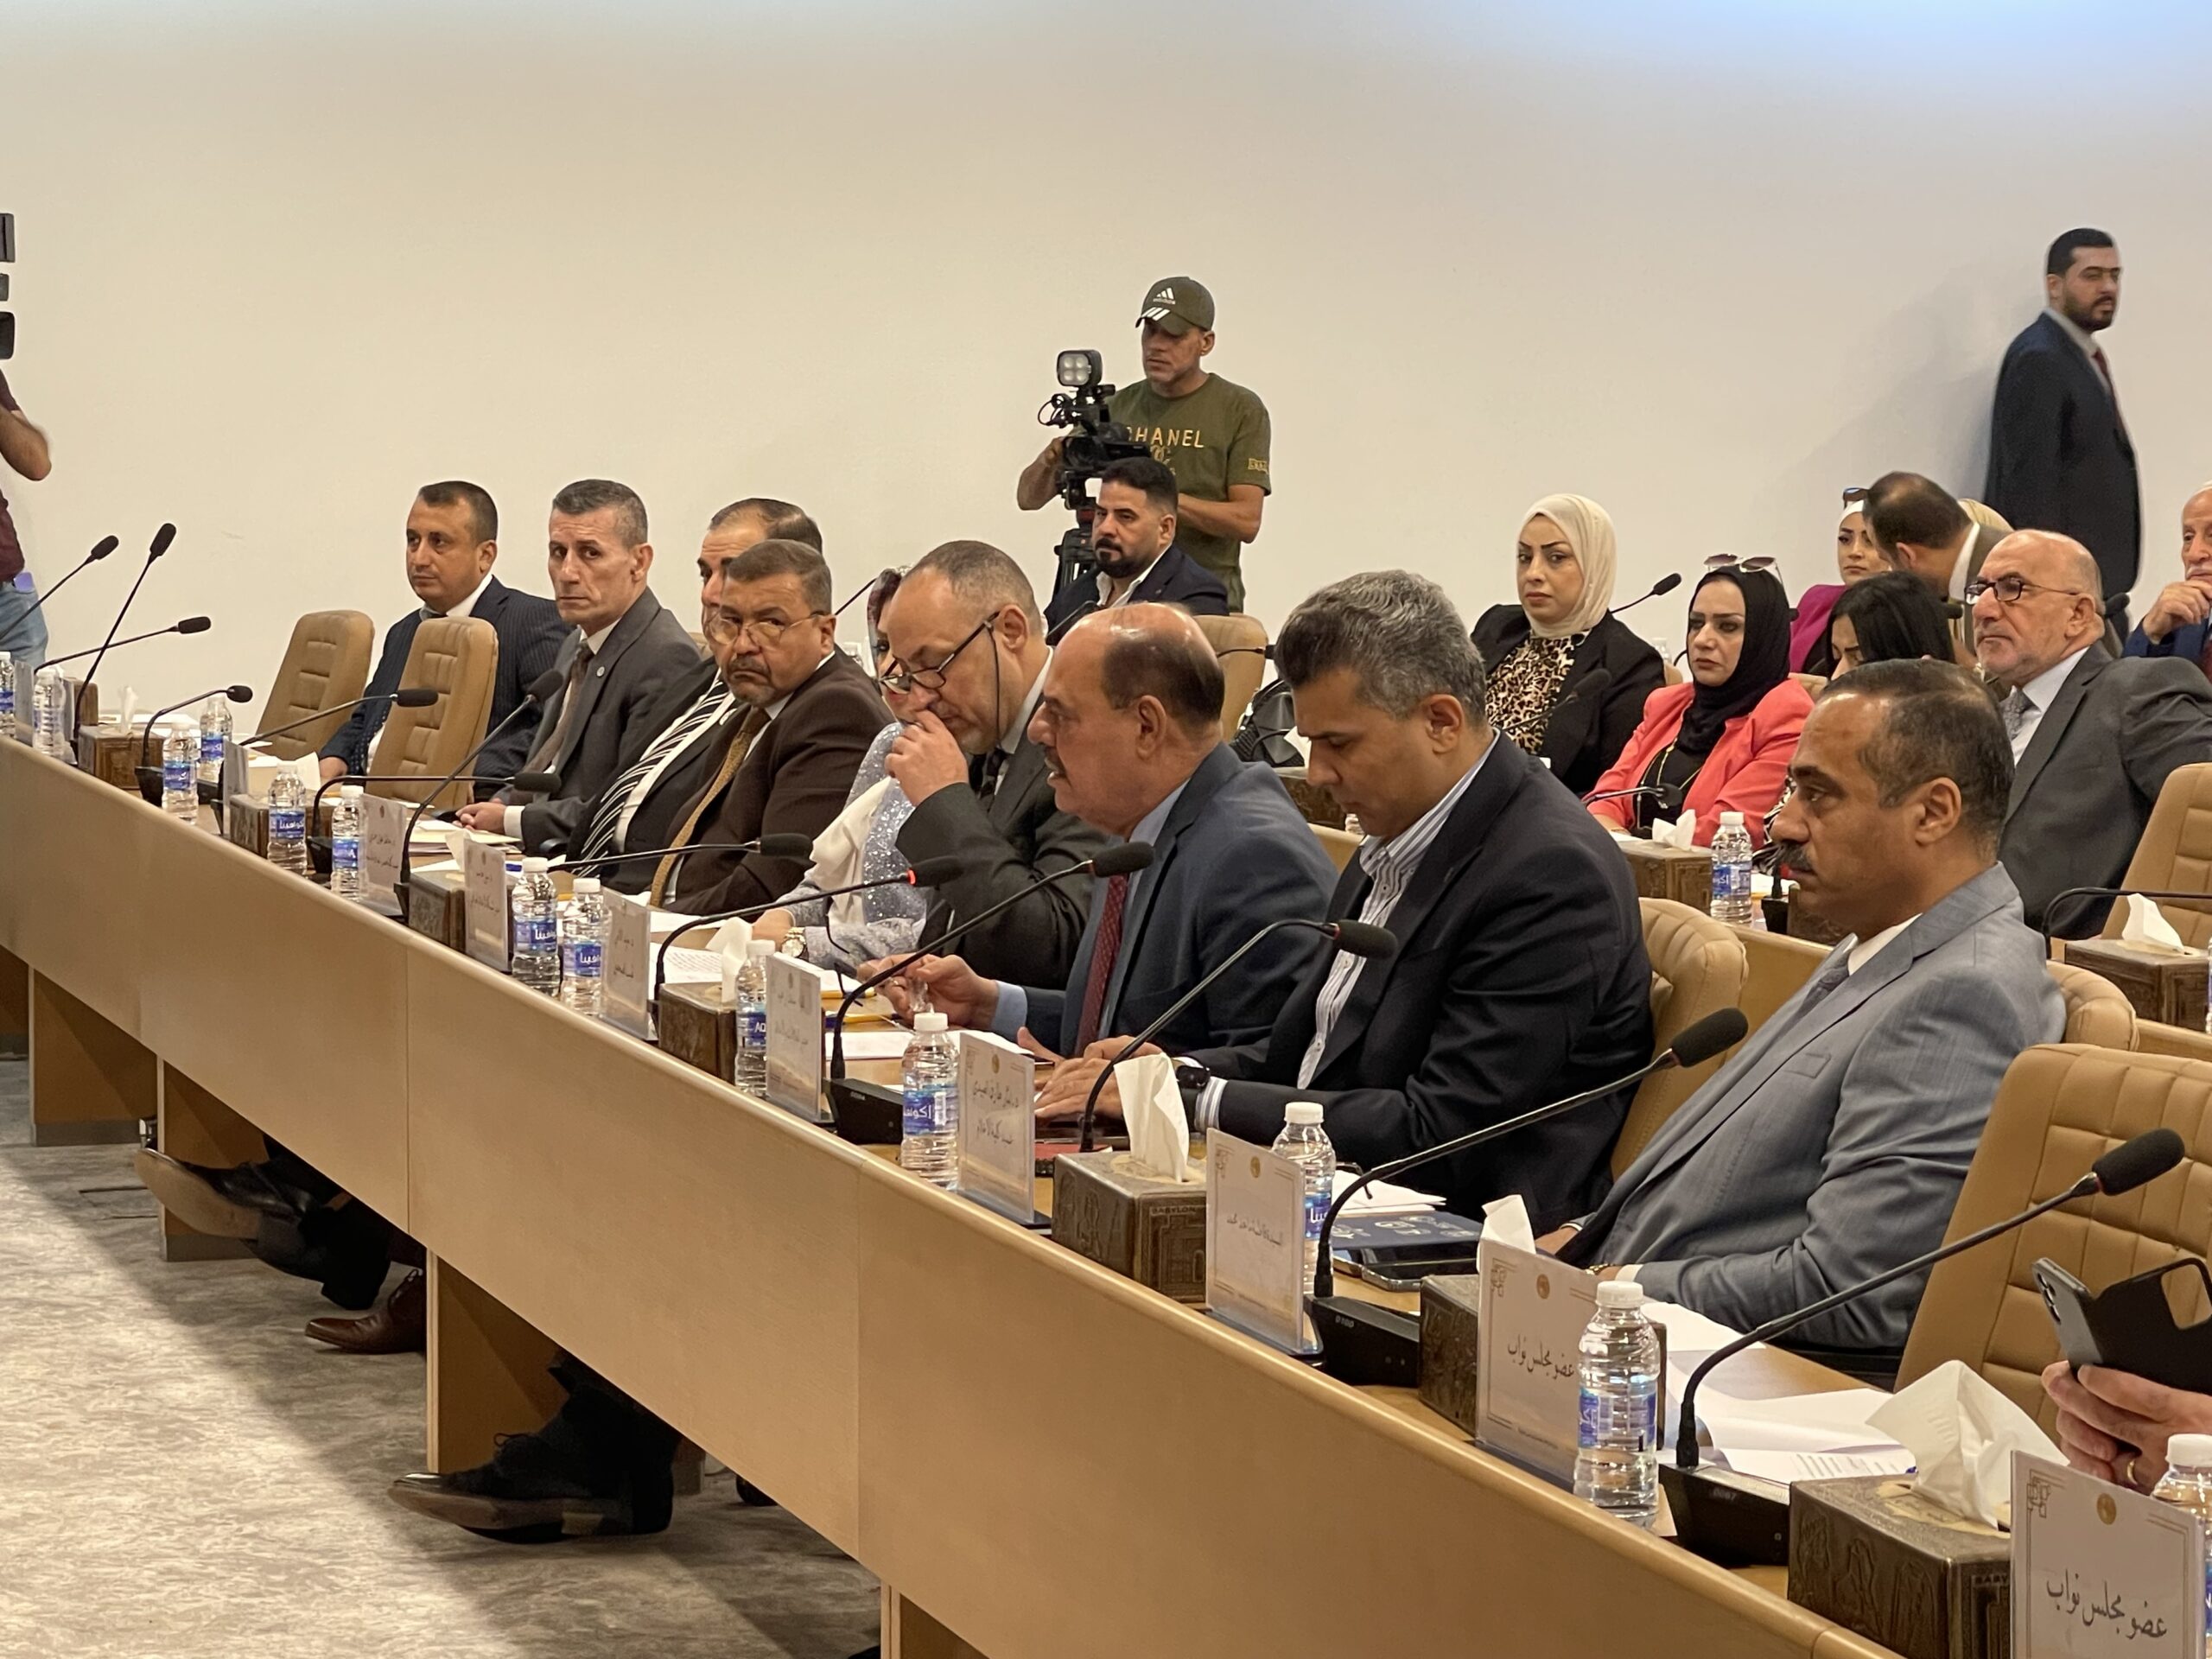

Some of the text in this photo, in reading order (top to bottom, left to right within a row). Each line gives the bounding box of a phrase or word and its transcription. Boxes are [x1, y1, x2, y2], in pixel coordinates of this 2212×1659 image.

[1151, 1205, 1197, 1215] BABYLON
[1507, 1333, 1575, 1380] عضو مجلس نواب
[1974, 1573, 2009, 1585] BABY
[2046, 1568, 2168, 1640] عضو مجلس نواب
